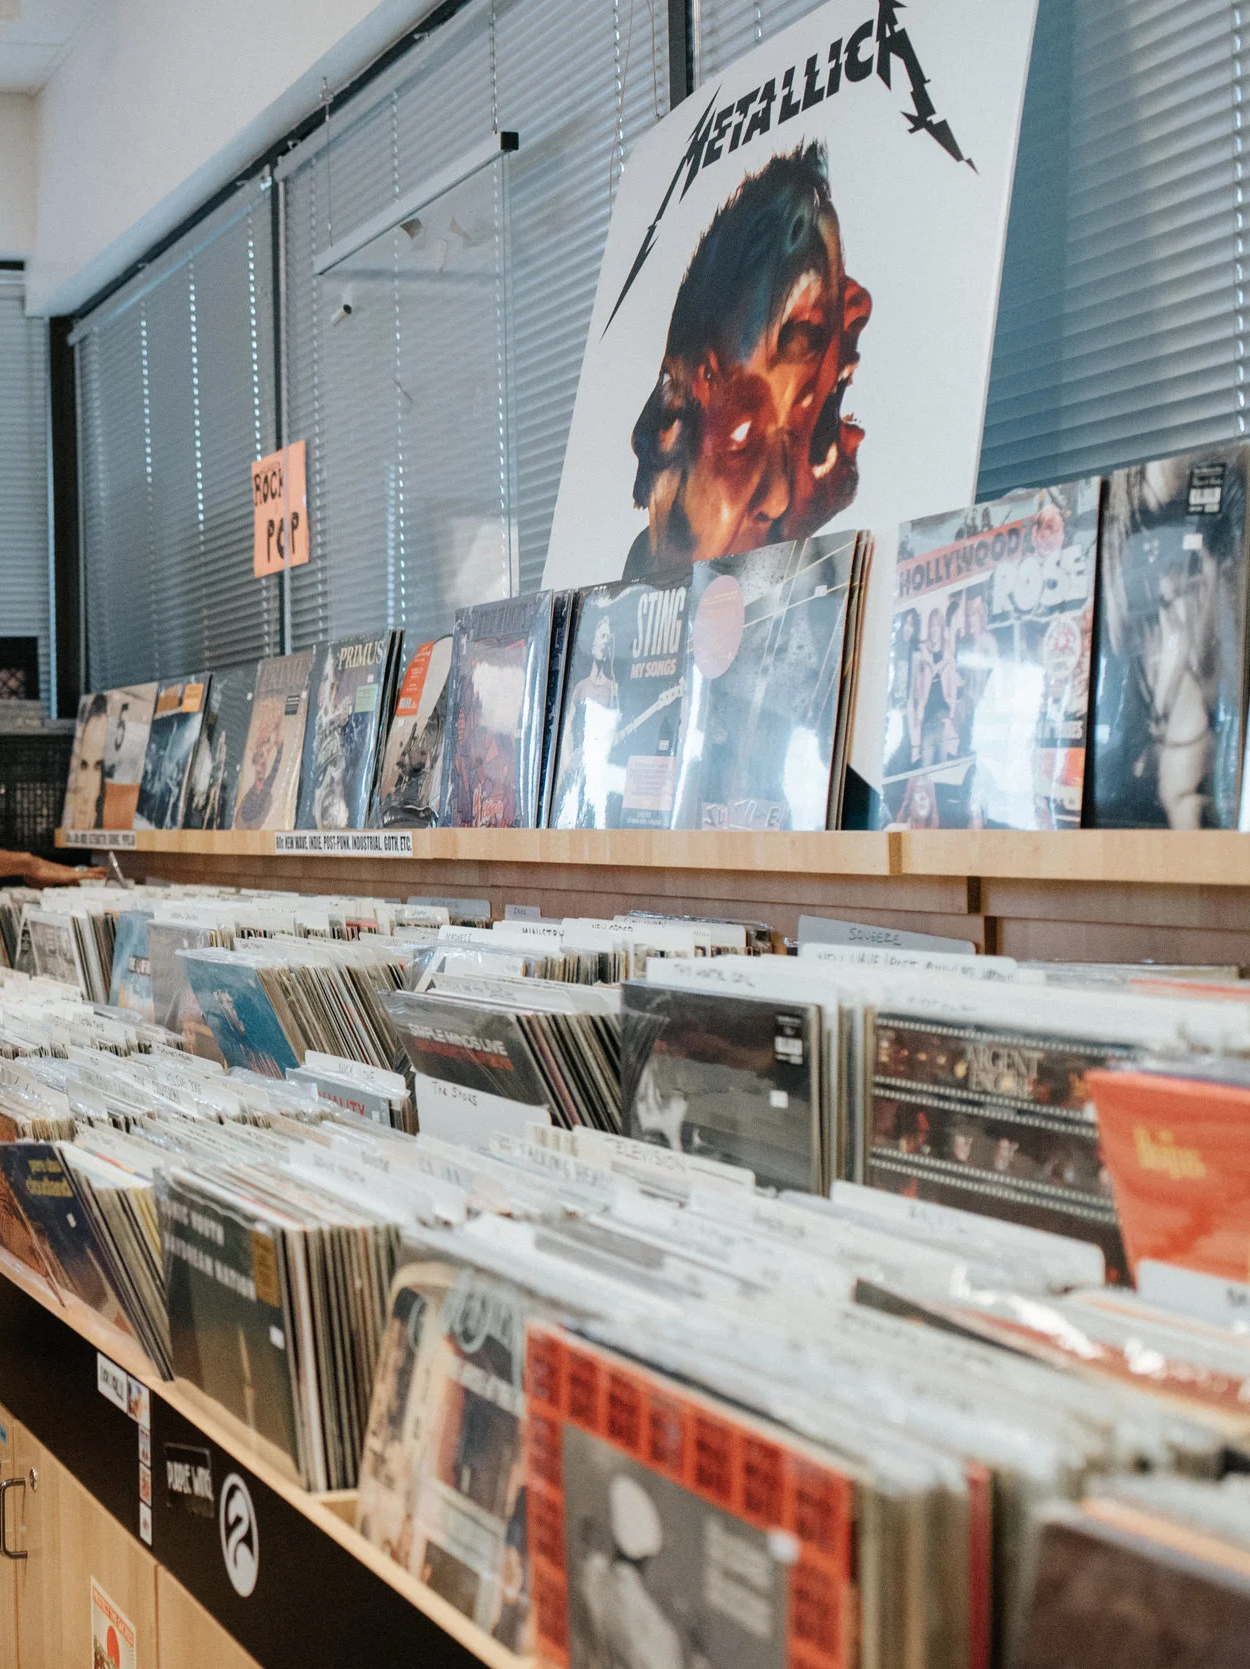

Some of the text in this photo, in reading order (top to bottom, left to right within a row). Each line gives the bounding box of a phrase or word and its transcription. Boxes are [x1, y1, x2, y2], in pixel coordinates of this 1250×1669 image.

[600, 0, 980, 344] METALLICA
[899, 527, 1020, 598] HOLLYWOOD
[631, 586, 688, 659] STING
[337, 640, 384, 671] PRIMUS
[630, 659, 677, 680] MY SONGS
[849, 927, 903, 947] SQUEEZE
[408, 1023, 446, 1042] SIMPLE
[447, 1030, 480, 1049] MINDS
[480, 1036, 508, 1056] LIVE
